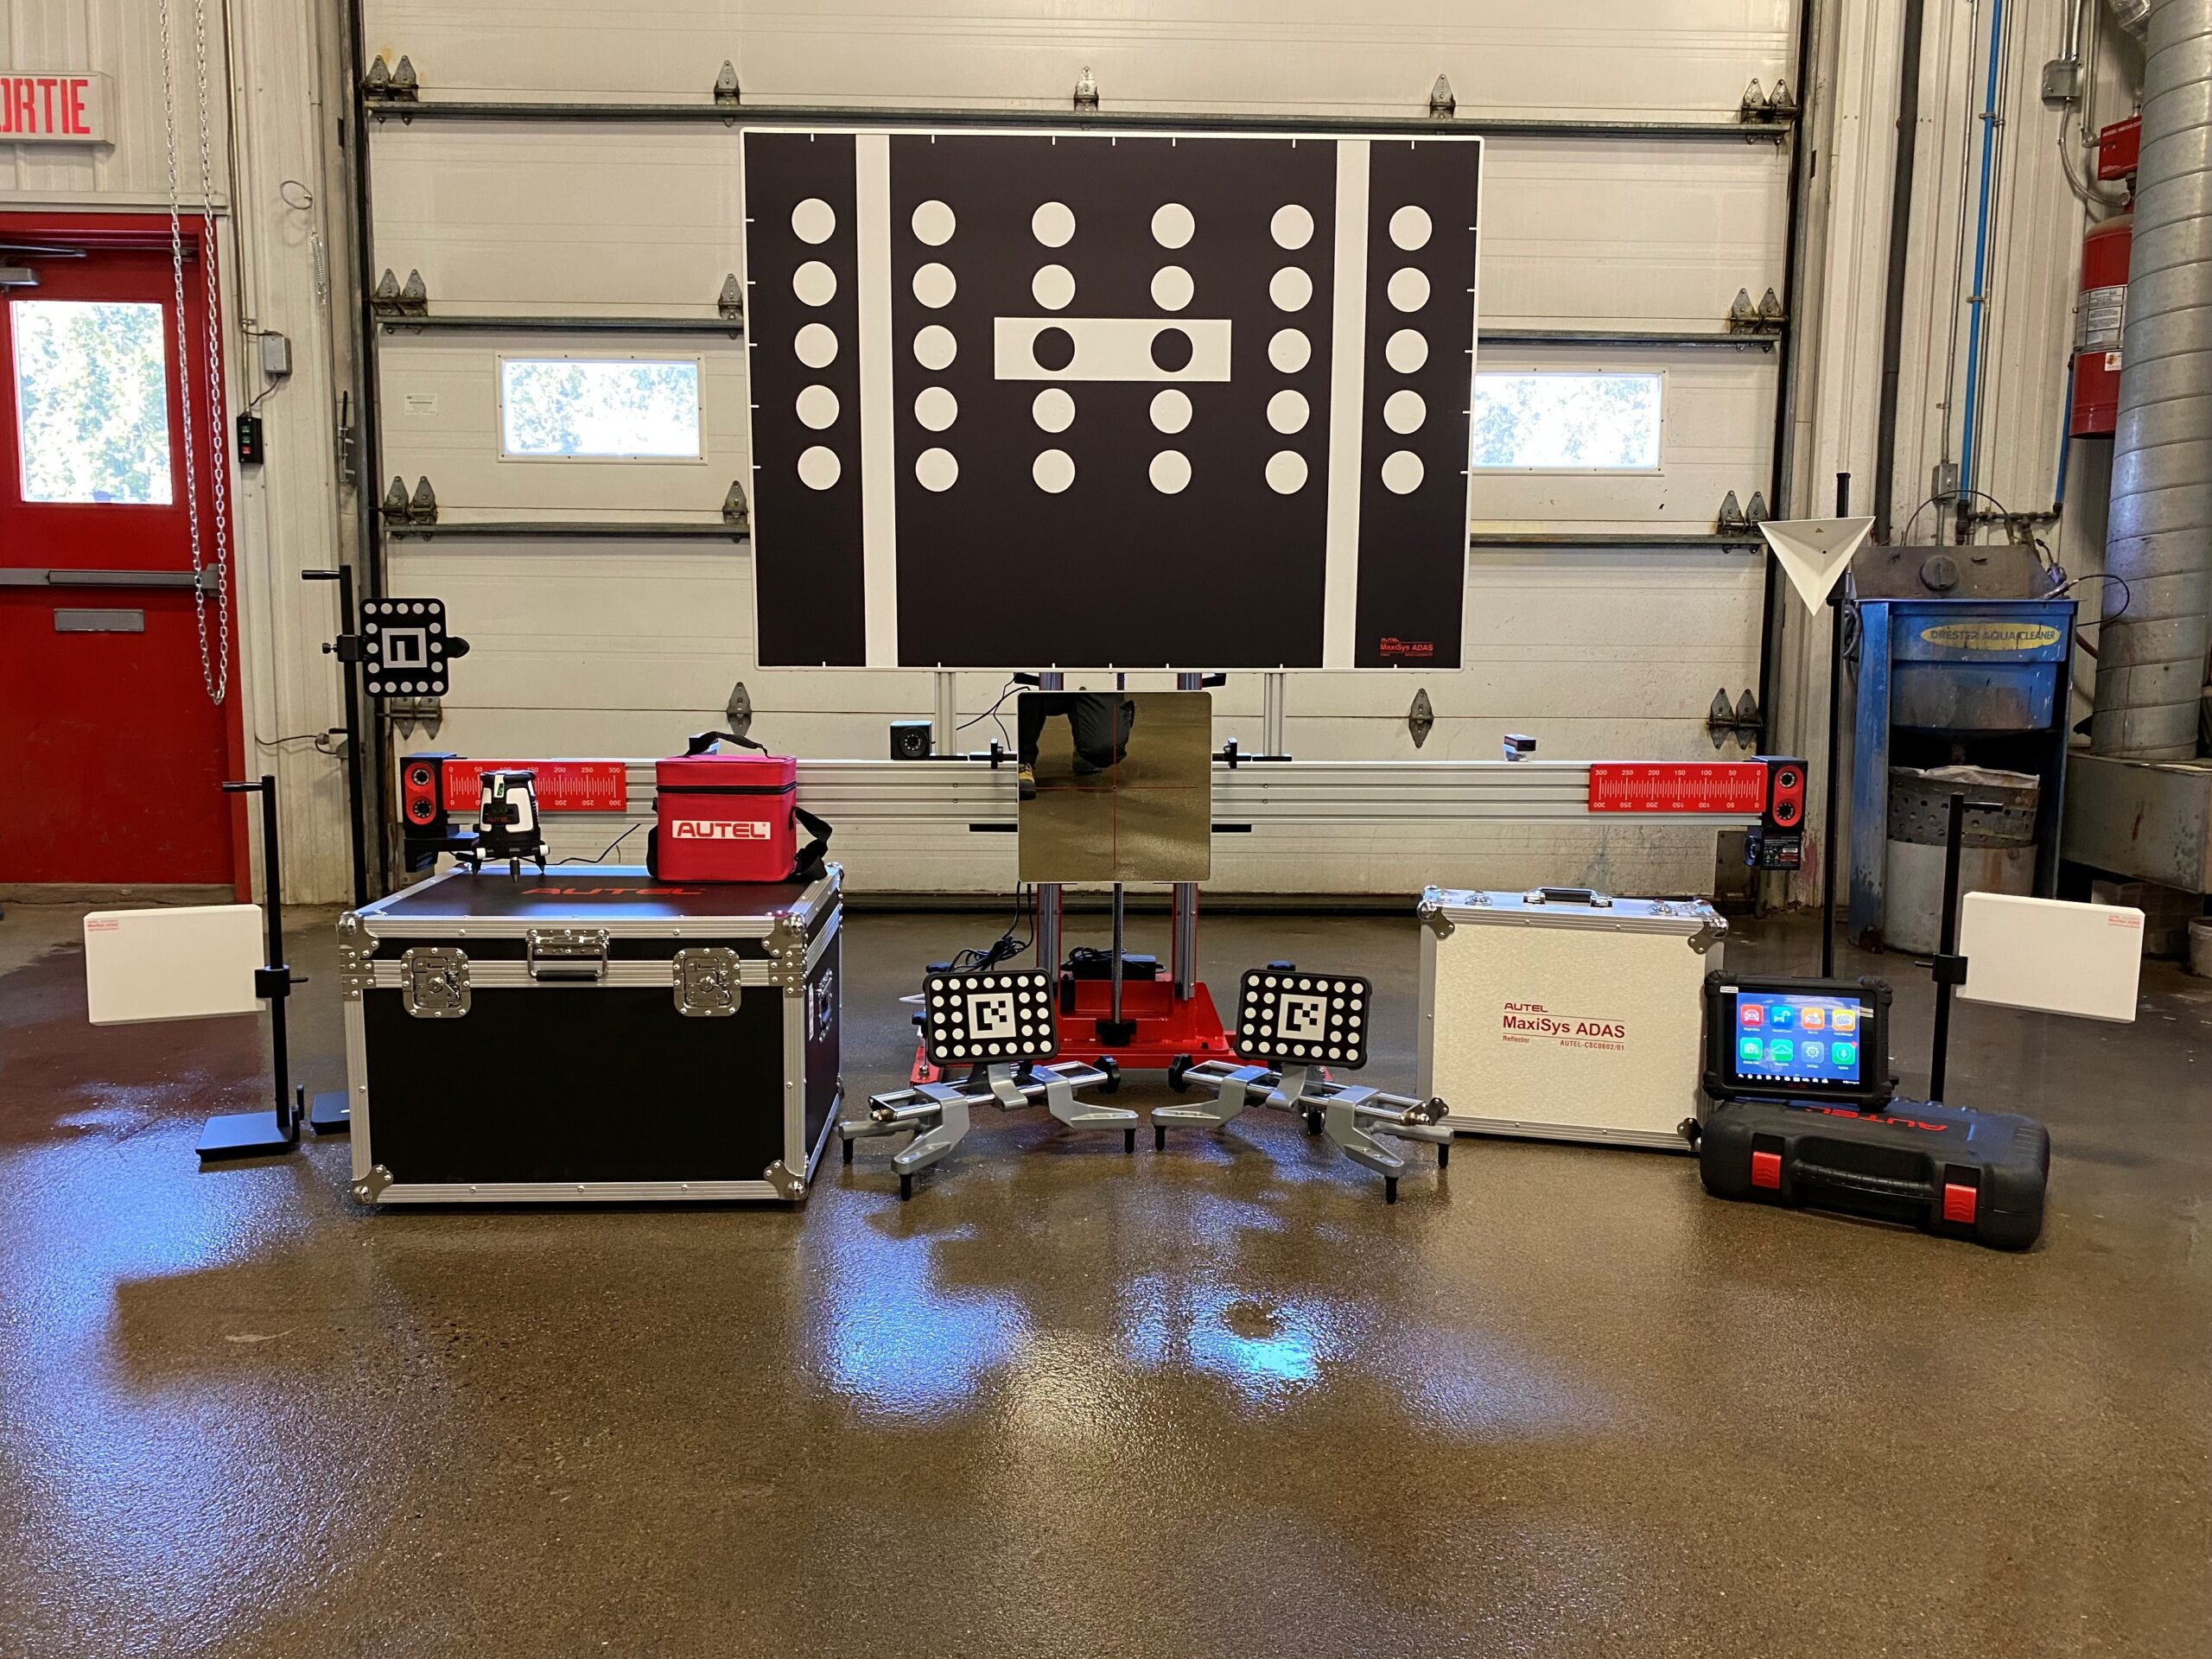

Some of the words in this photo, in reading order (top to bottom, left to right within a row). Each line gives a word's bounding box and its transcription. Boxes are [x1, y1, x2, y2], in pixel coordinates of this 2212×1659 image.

[1983, 631, 2015, 639] AQUA
[2018, 631, 2055, 639] CLEANER
[677, 823, 766, 838] AUTEL
[1504, 1003, 1548, 1013] AUTEL
[1503, 1015, 1570, 1035] MaxiSys
[1576, 1022, 1625, 1038] ADAS
[1503, 1035, 1529, 1044] Reflector
